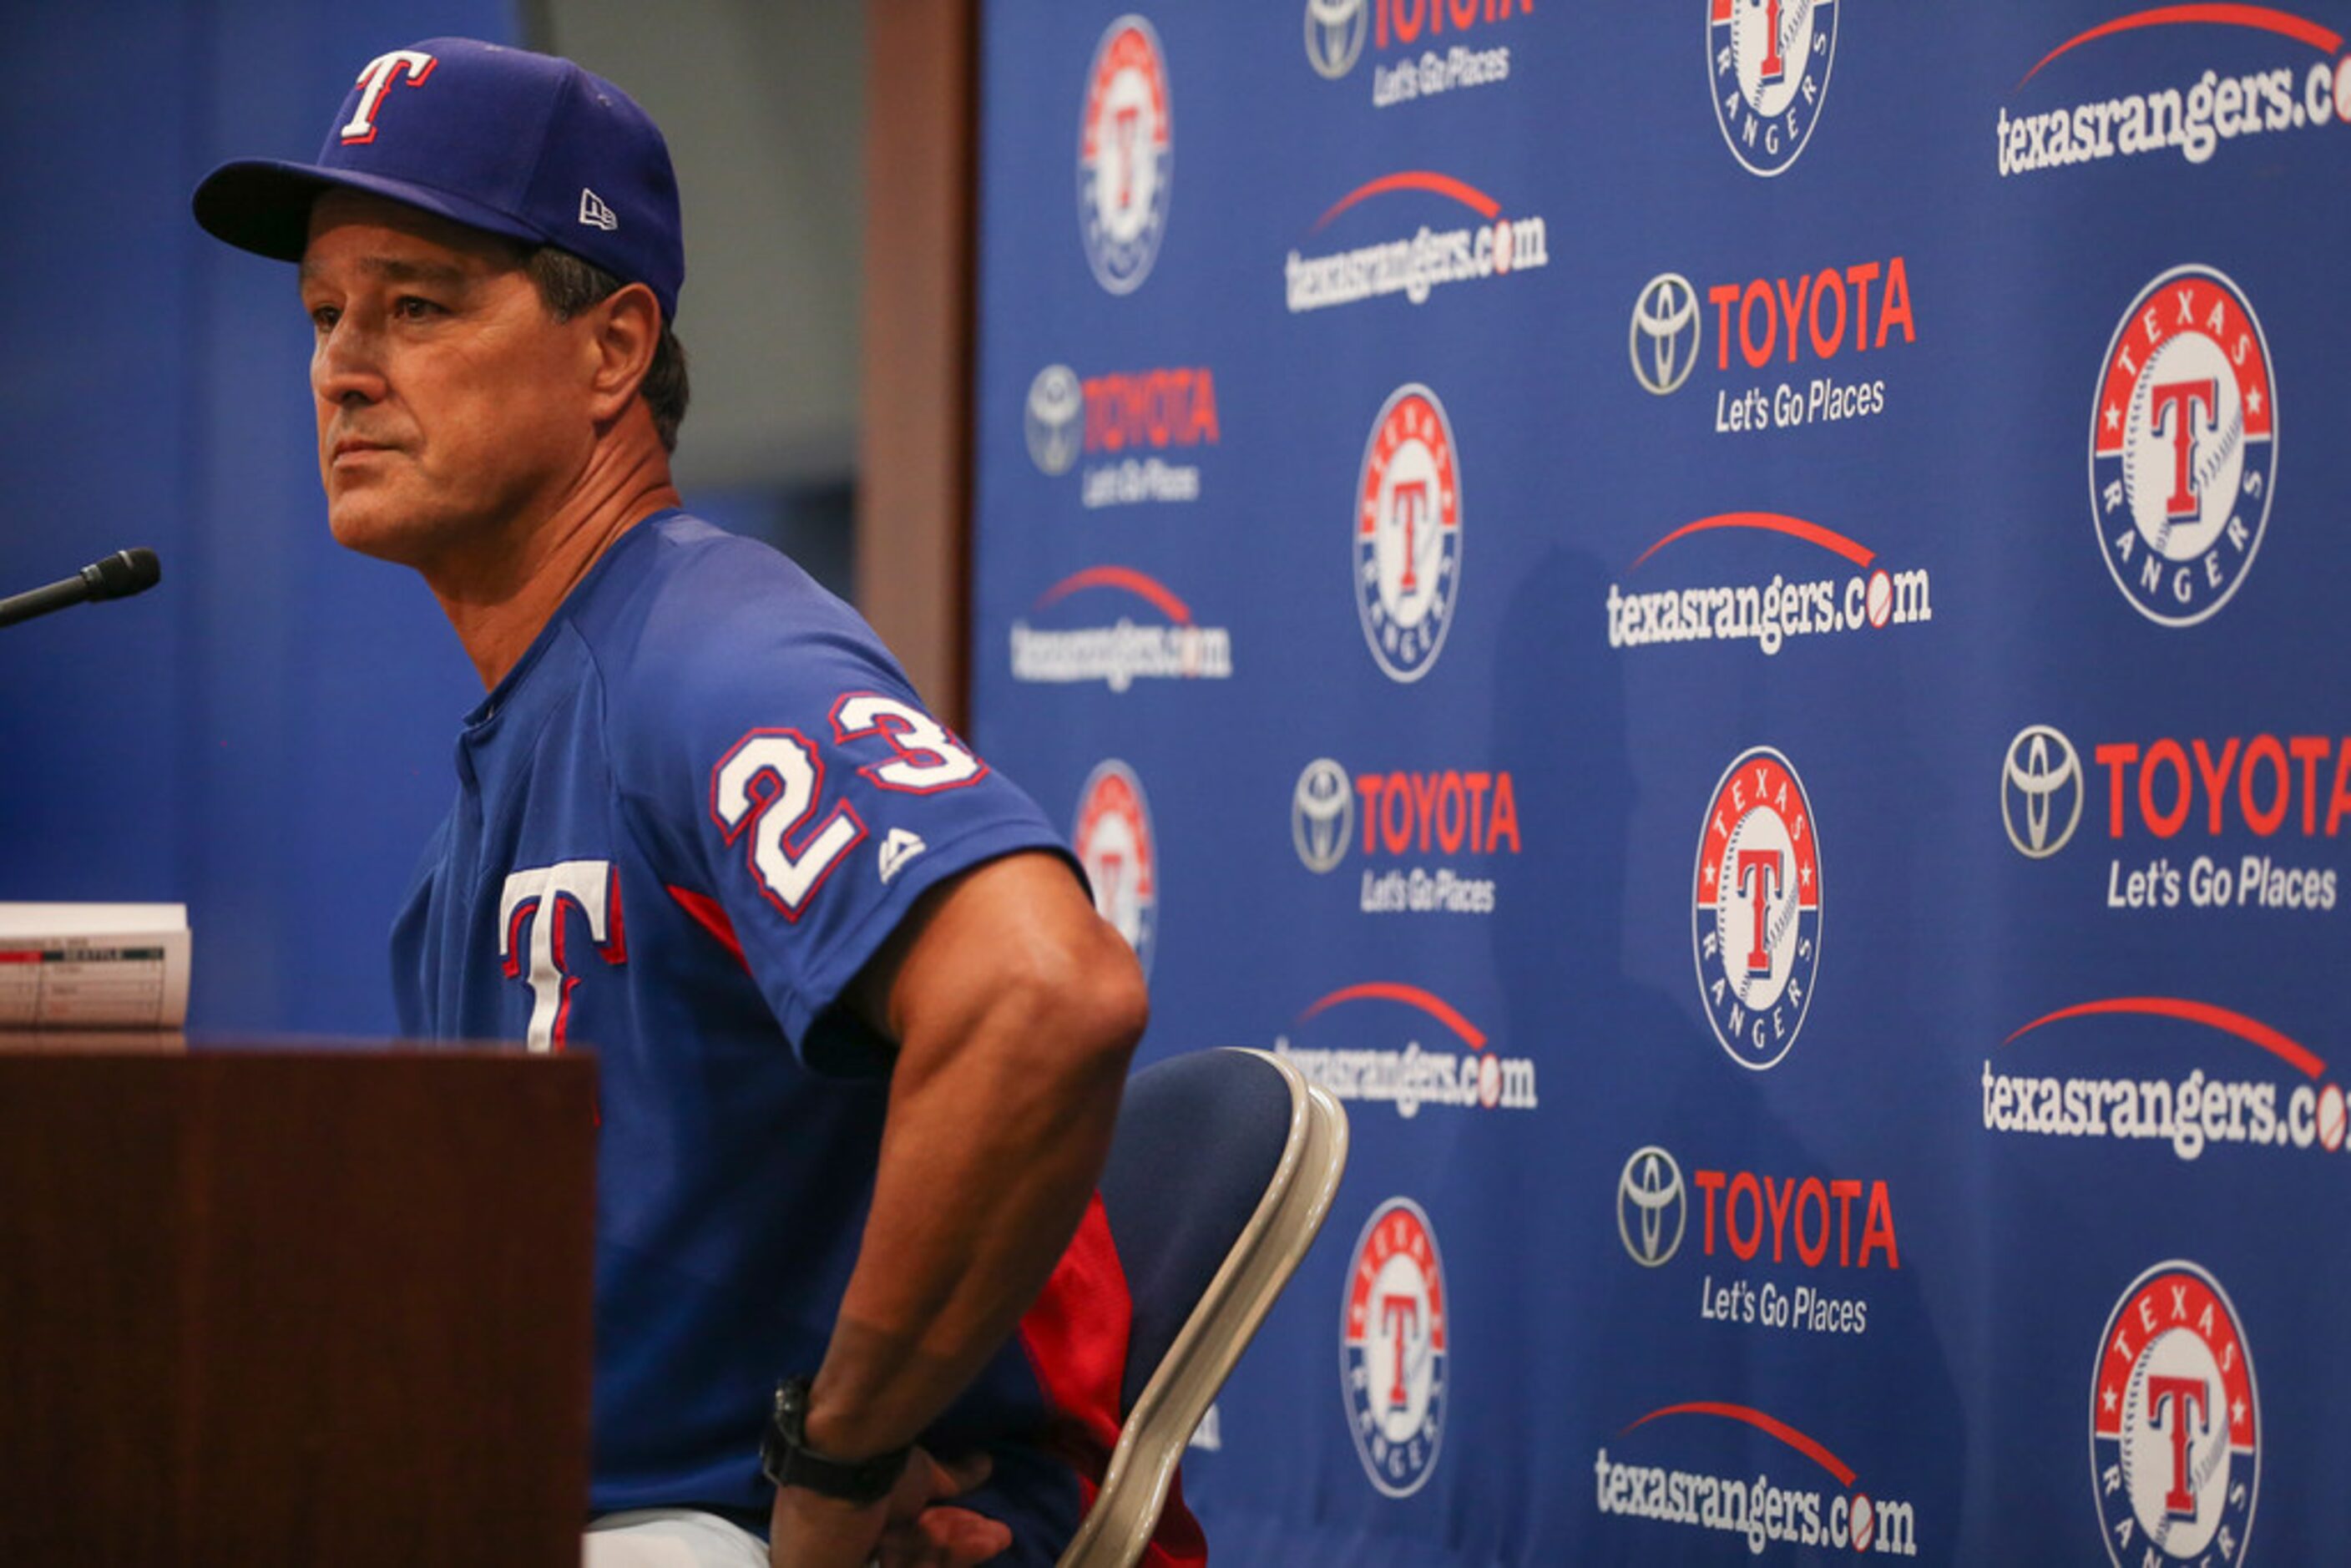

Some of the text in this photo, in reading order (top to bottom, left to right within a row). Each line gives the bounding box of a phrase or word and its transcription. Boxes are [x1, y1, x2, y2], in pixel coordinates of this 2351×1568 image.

[341, 50, 438, 145] T
[1716, 31, 1827, 154] RANGERS
[1709, 256, 1916, 370] TOYOTA
[2116, 289, 2252, 377] TEXAS
[1716, 377, 1885, 432] Let's Go Places
[2150, 377, 2220, 525] T
[1392, 478, 1428, 596] T
[2103, 470, 2263, 603] RANGERS
[1605, 569, 1931, 655] texasrangers.com
[710, 691, 989, 923] 23
[1355, 769, 1521, 855] TOYOTA
[1712, 767, 1806, 842] TEXAS
[2095, 733, 2351, 839] TOYOTA
[1737, 849, 1785, 980] T
[2106, 855, 2337, 910] Let's Go Places
[499, 859, 628, 1054] T
[1701, 931, 1813, 1050] RANGERS
[1982, 1058, 2351, 1161] texasrangers.co
[1695, 1170, 1900, 1269] TOYOTA
[1383, 1294, 1418, 1412] T
[1701, 1276, 1867, 1333] Let's Go Places
[2113, 1285, 2237, 1373] TEXAS
[1595, 1447, 1917, 1556] texasrangers.com
[2147, 1374, 2209, 1524] T
[2102, 1464, 2247, 1568] RANRS
